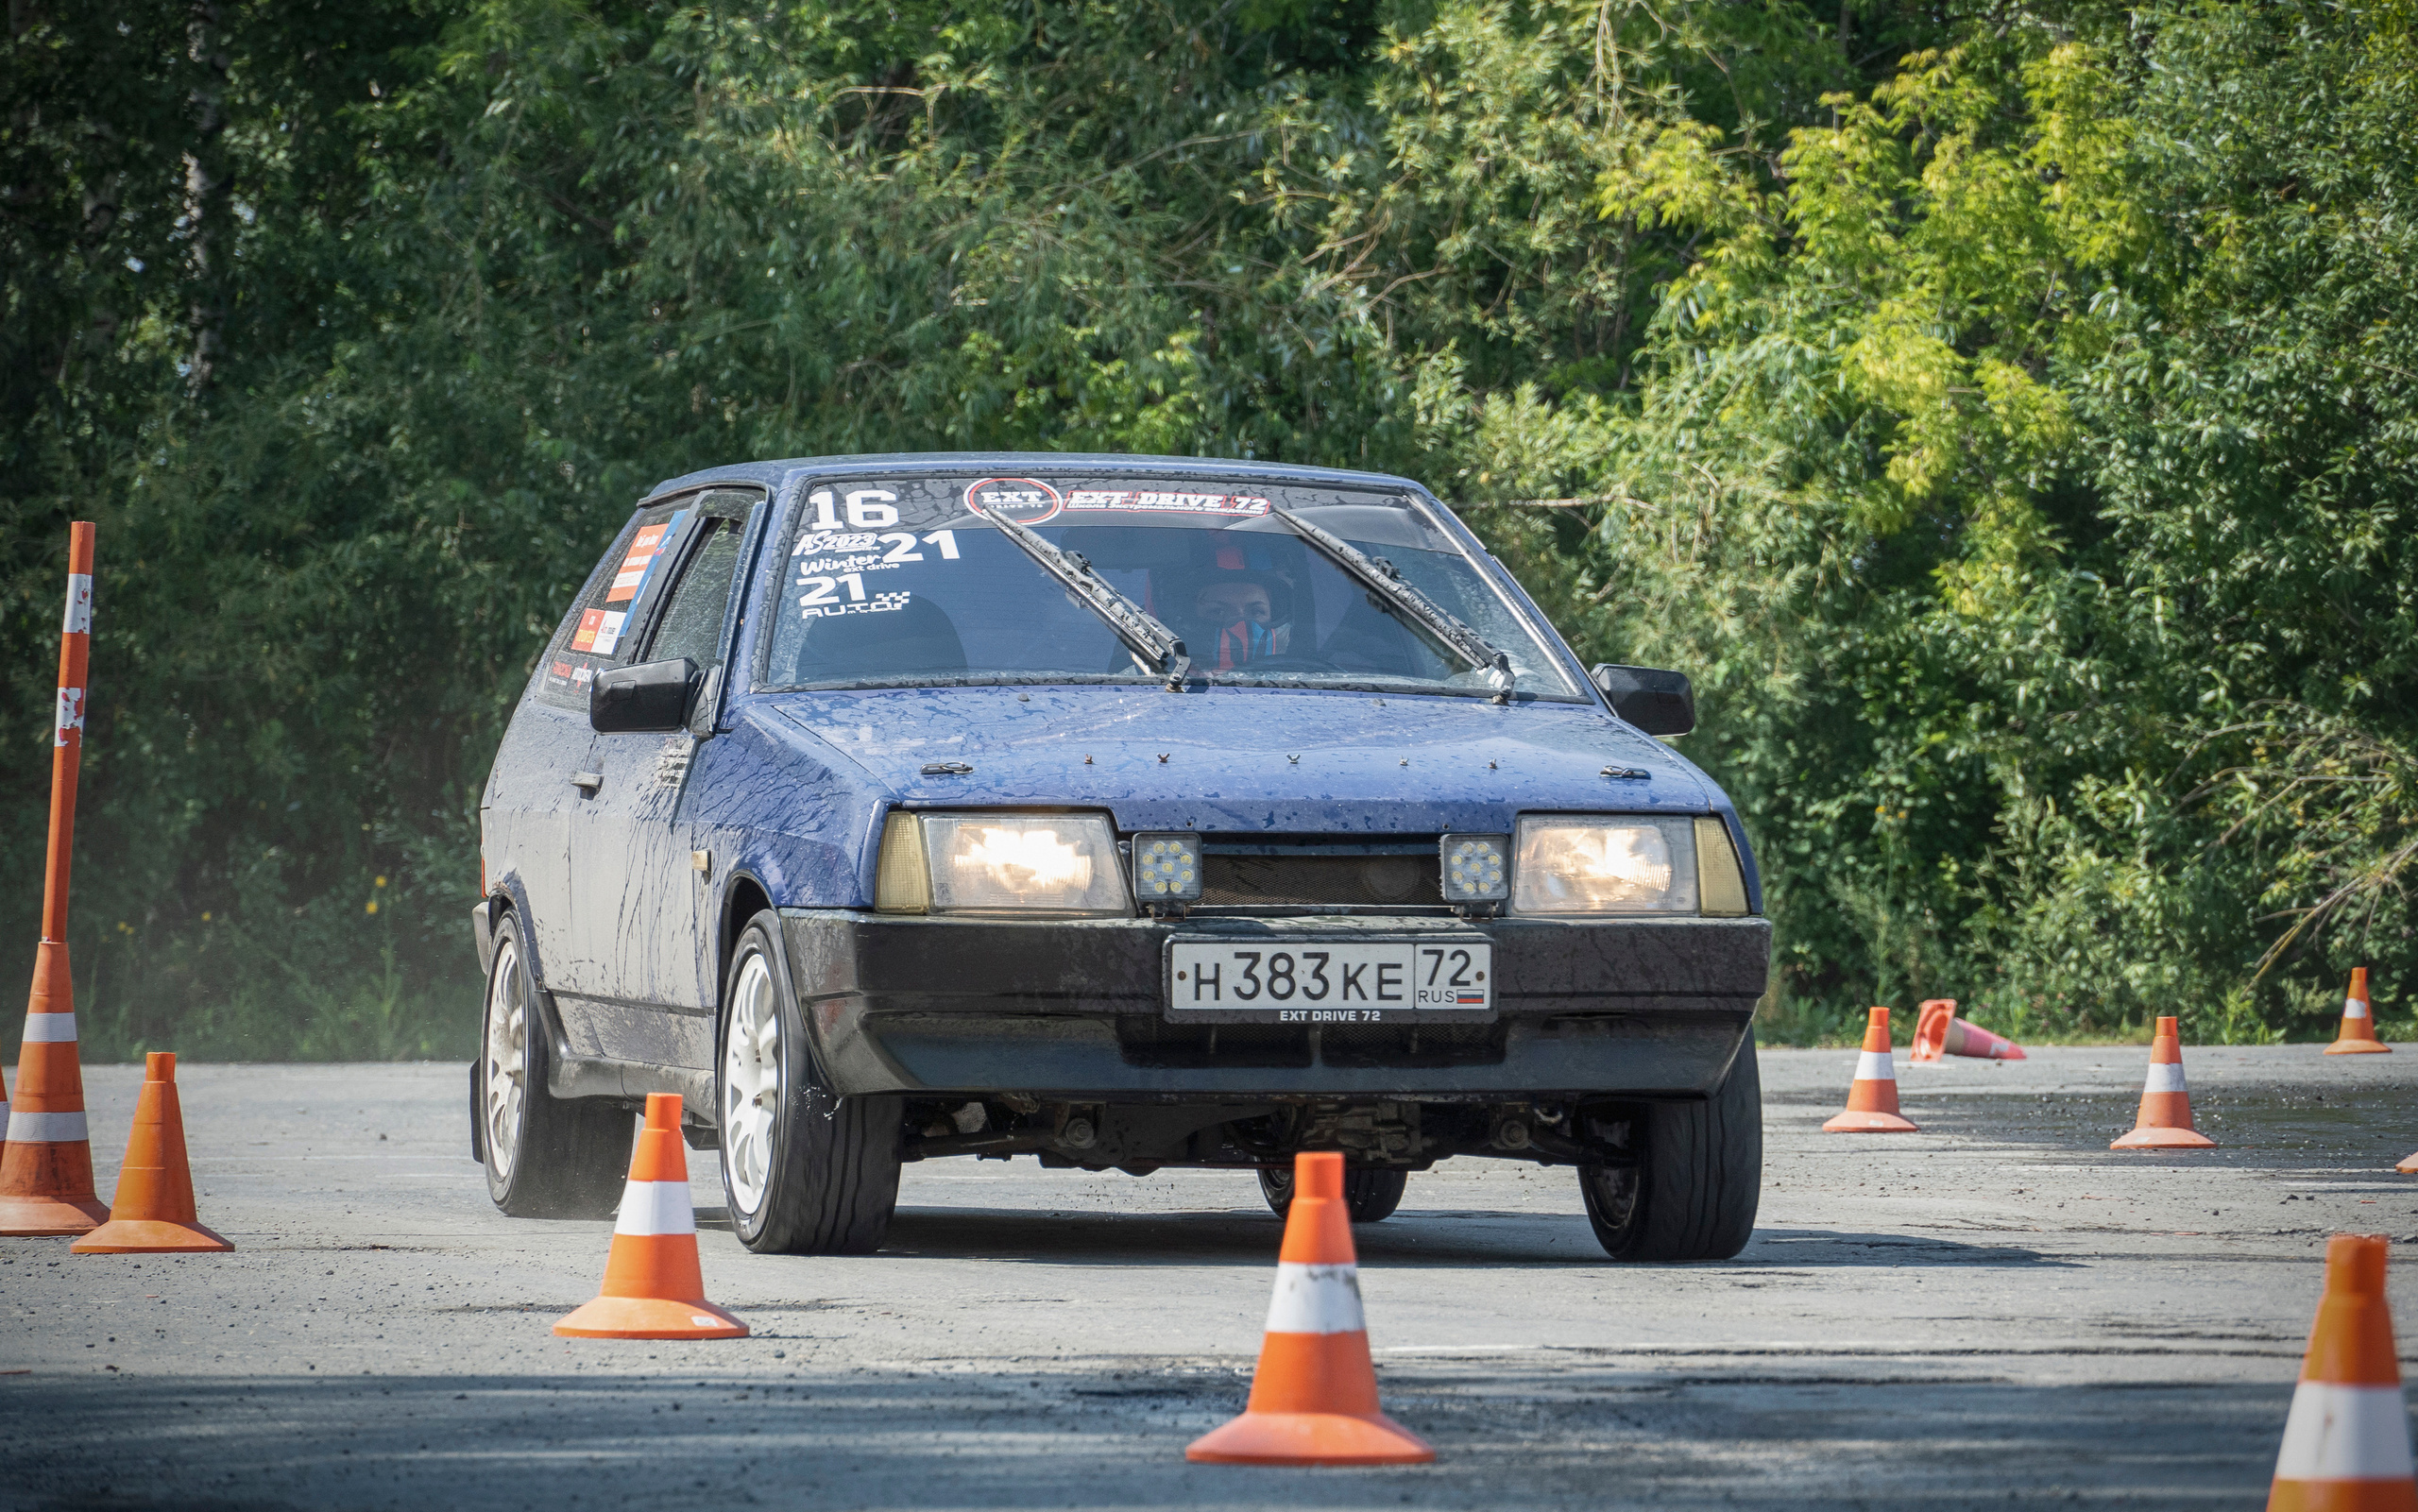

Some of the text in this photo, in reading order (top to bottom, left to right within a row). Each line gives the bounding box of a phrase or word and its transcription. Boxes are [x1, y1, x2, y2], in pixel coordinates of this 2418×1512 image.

[980, 491, 1043, 503] EXT
[1069, 491, 1268, 511] EXT DRIVE 72
[809, 489, 899, 531] 16
[877, 529, 961, 563] 21
[800, 554, 881, 576] Winter
[843, 565, 865, 573] ext
[795, 572, 866, 606] 21
[1422, 949, 1471, 987] 72
[1418, 990, 1455, 1003] RUS
[1280, 1011, 1381, 1021] EXT DRIVE 72
